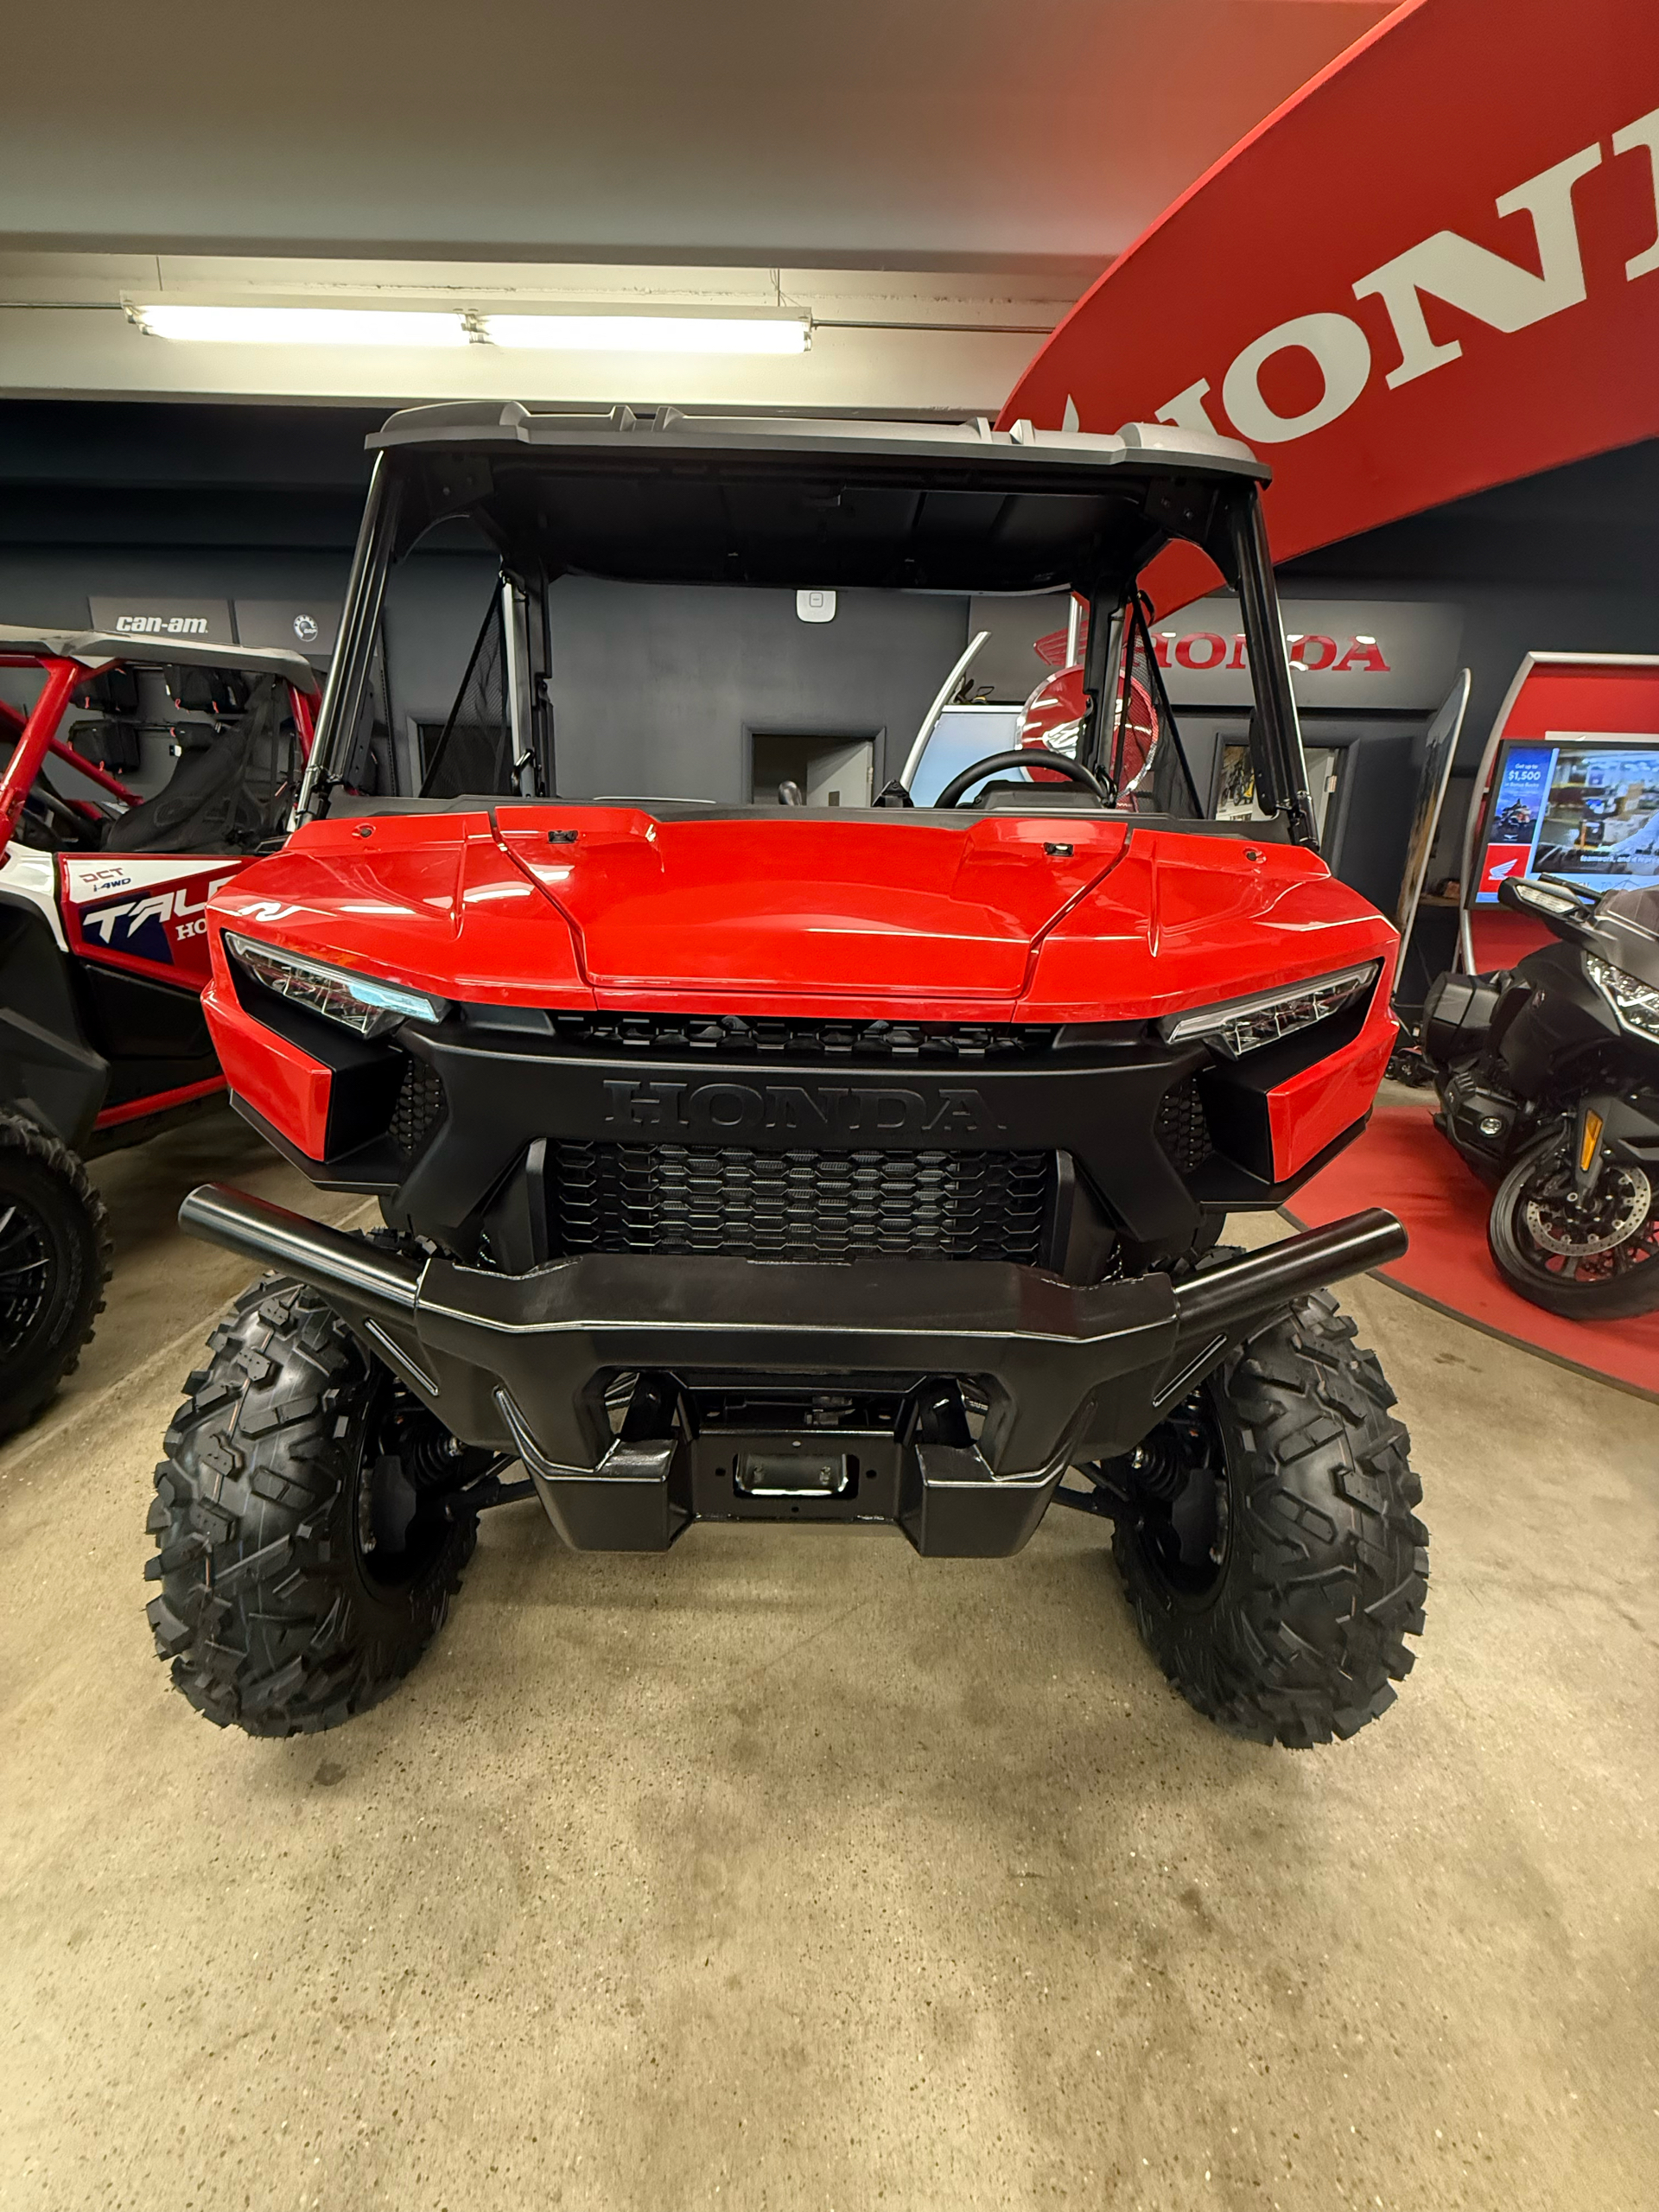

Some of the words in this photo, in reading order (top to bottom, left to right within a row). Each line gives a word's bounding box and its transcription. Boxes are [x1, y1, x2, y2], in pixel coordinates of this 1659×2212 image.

[1508, 770, 1541, 781] $1,500
[79, 868, 123, 883] DCT
[602, 1079, 1007, 1130] HONDA
